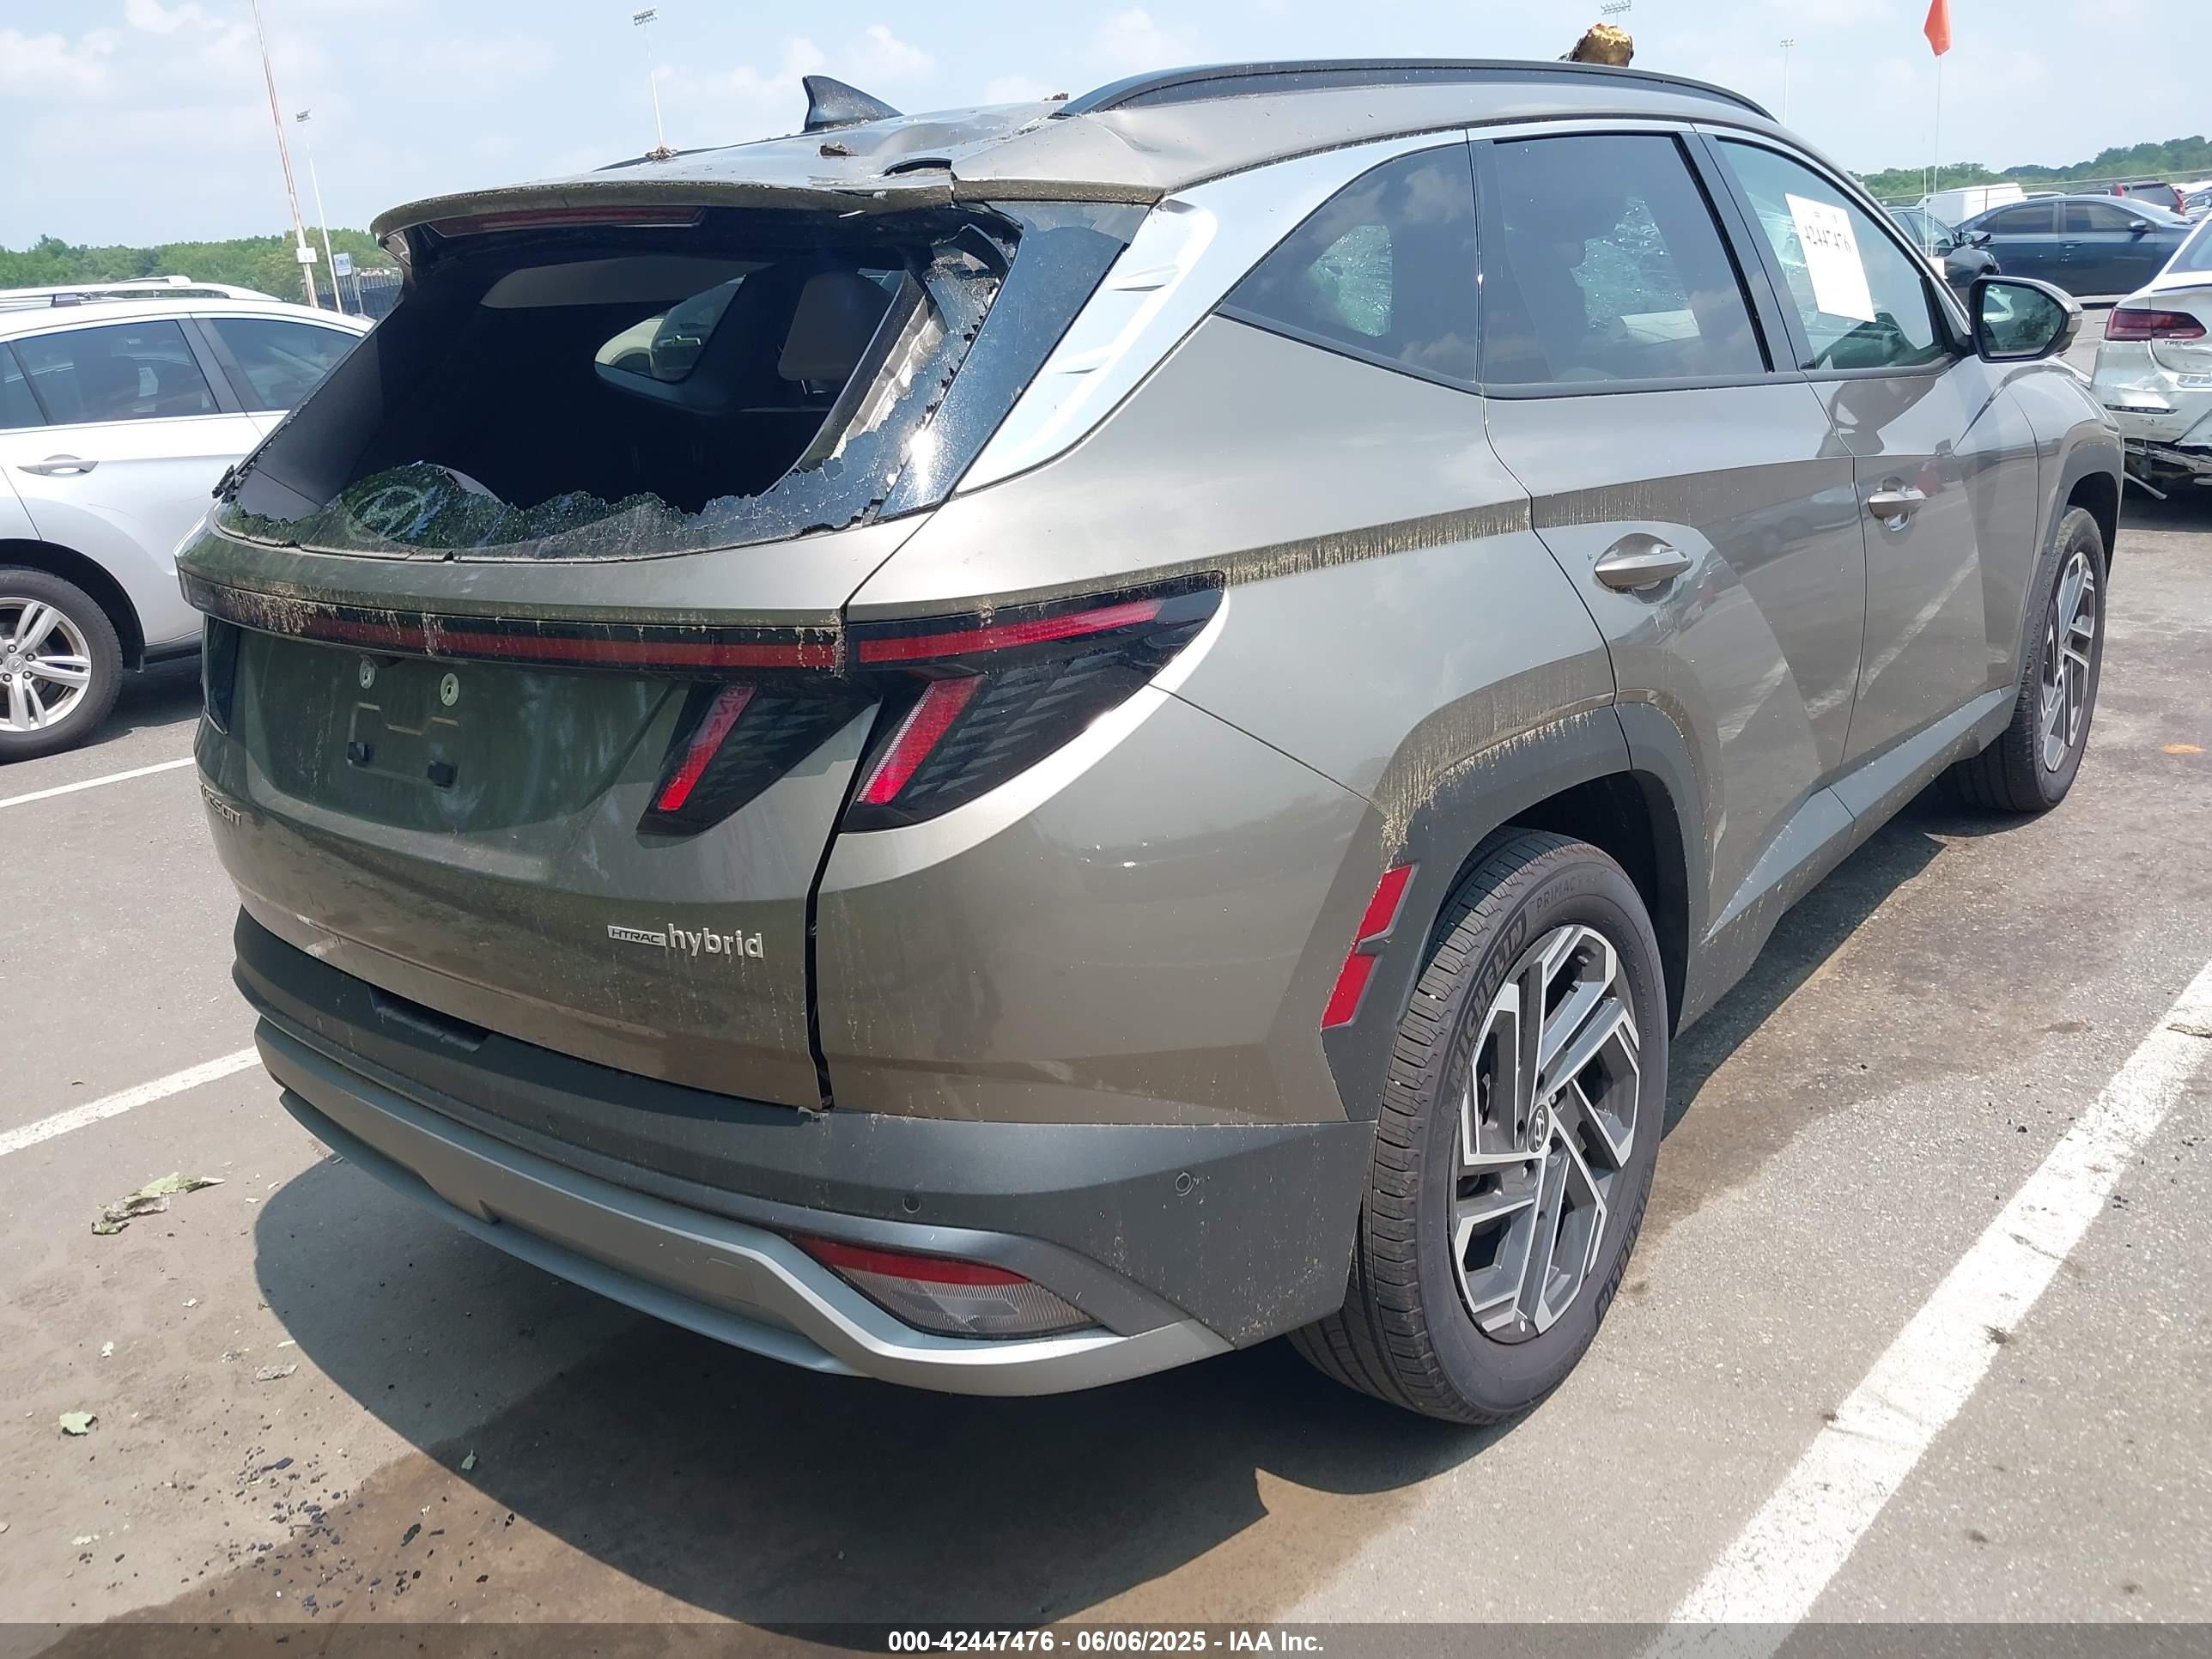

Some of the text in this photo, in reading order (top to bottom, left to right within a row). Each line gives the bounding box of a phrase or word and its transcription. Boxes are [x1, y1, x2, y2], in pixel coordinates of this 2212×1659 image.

[611, 922, 764, 959] HTRAC hybrid
[1449, 920, 1523, 1090] MICHELIN
